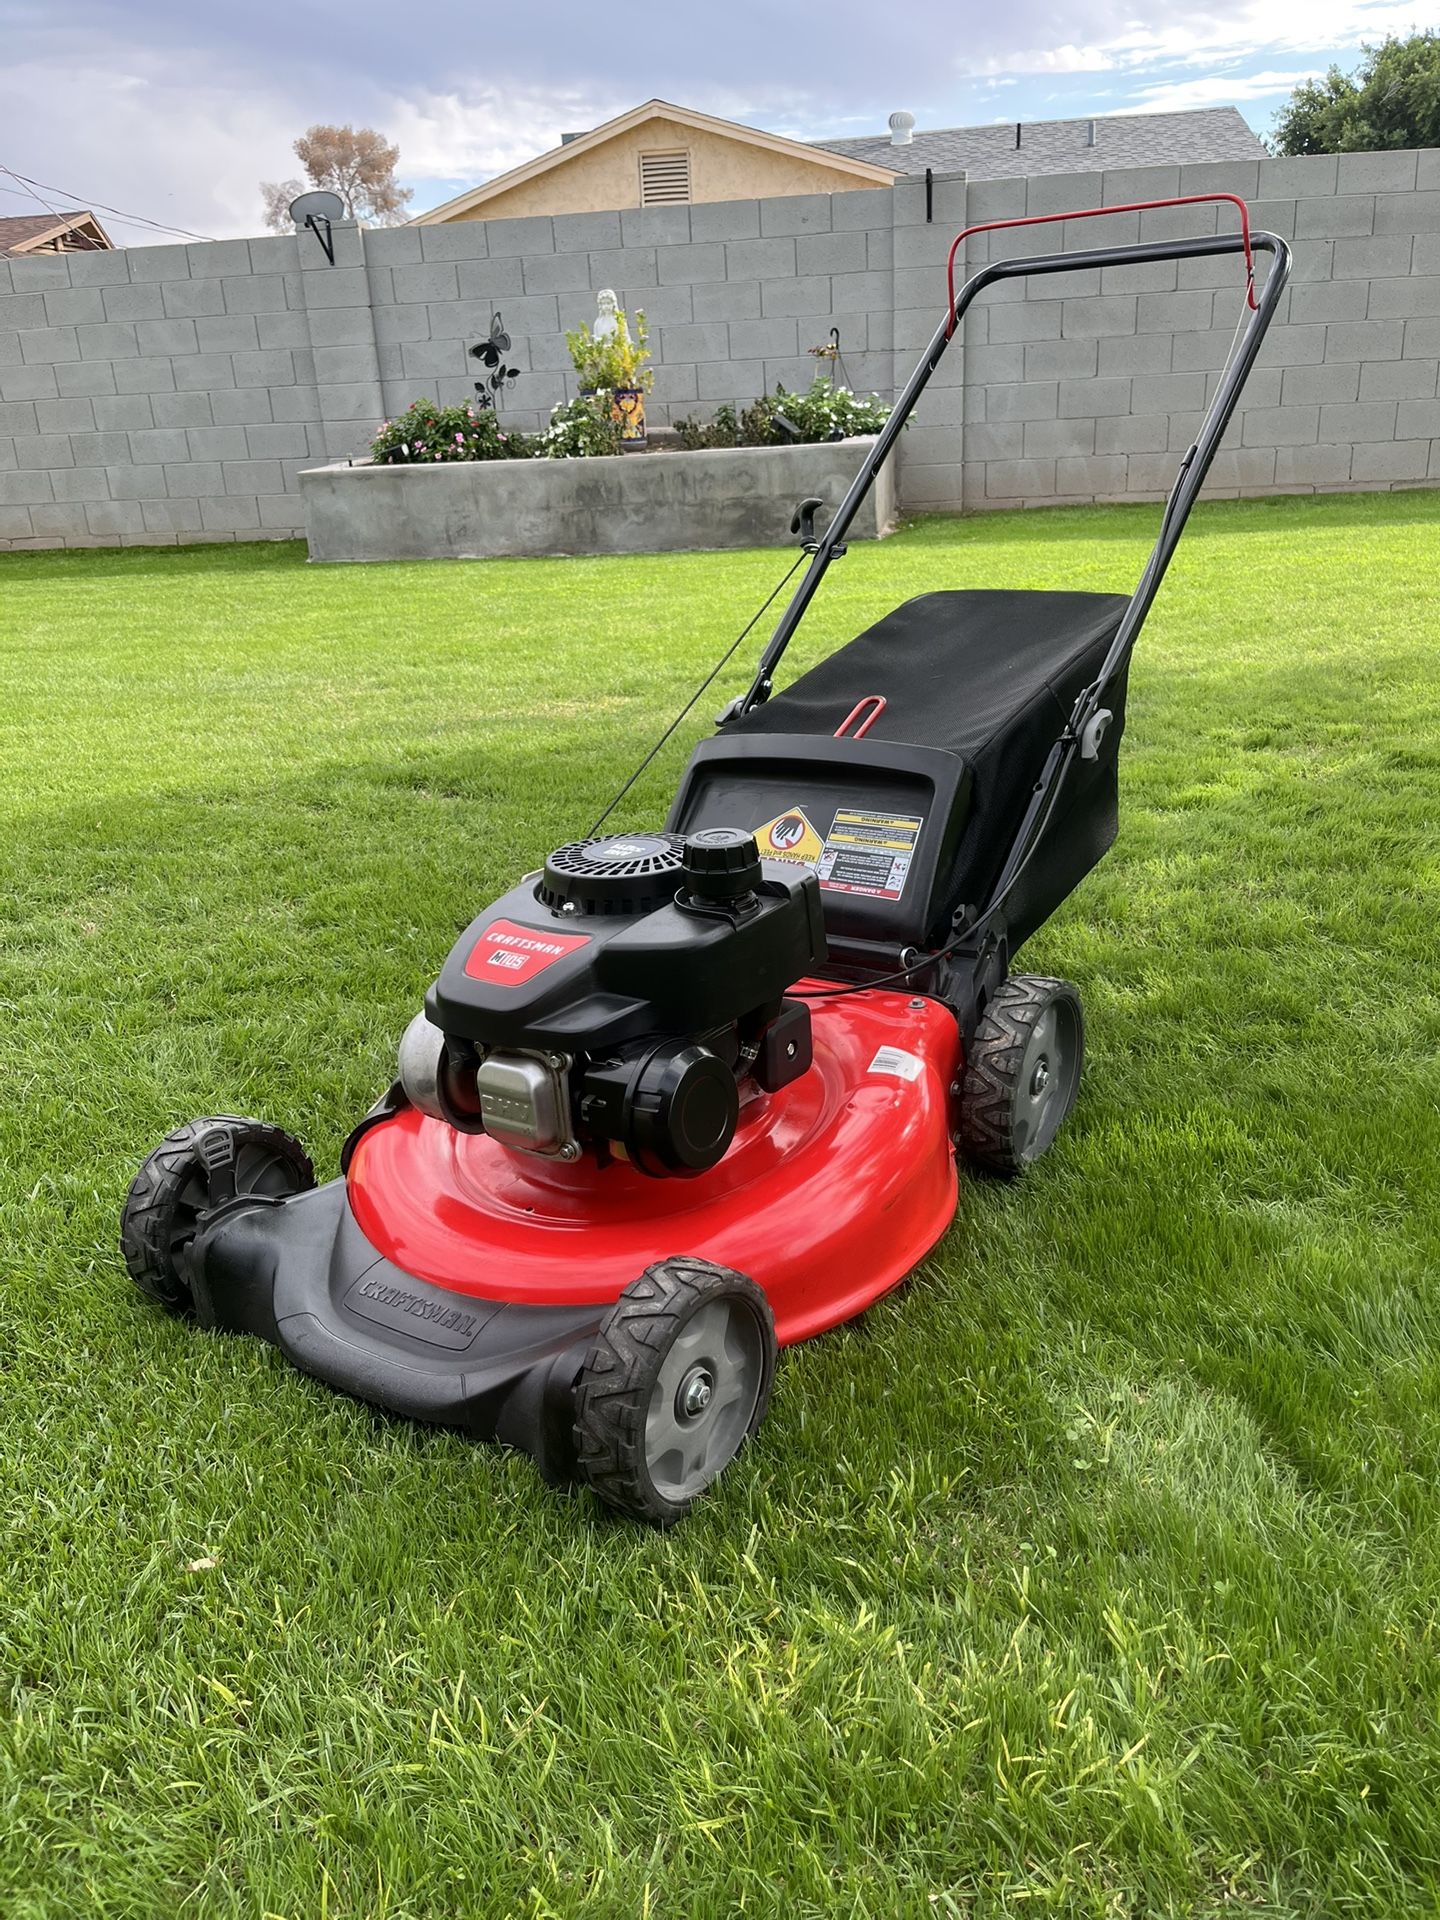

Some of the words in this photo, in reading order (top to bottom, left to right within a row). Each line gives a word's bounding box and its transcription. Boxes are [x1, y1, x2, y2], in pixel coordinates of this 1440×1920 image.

[854, 836, 884, 844] WARNING
[801, 853, 815, 861] KEEP
[851, 886, 876, 894] DANGER
[486, 932, 565, 955] CRAFTSMAN
[358, 1280, 477, 1335] CRAFTSMAN
